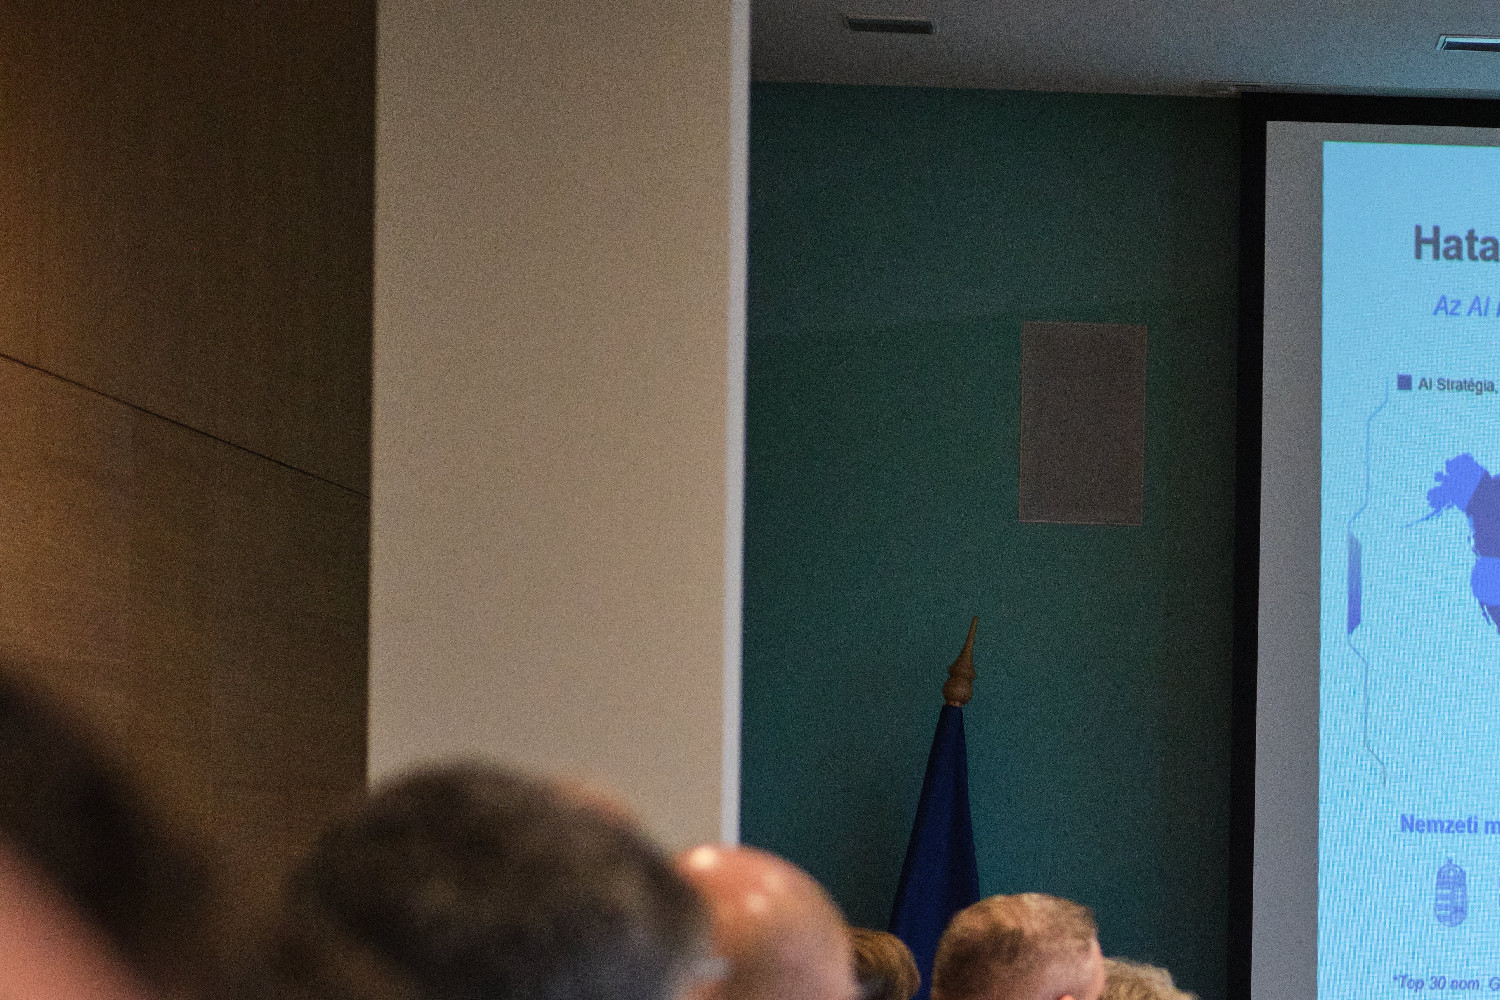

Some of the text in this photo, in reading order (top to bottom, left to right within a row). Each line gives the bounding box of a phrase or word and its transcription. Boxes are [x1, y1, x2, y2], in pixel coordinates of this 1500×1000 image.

[1433, 295, 1461, 316] Az
[1467, 296, 1489, 317] AI
[1419, 378, 1432, 391] AI
[1437, 377, 1498, 395] Stratégia,
[1401, 814, 1478, 834] Nemzeti
[1429, 976, 1446, 990] 30
